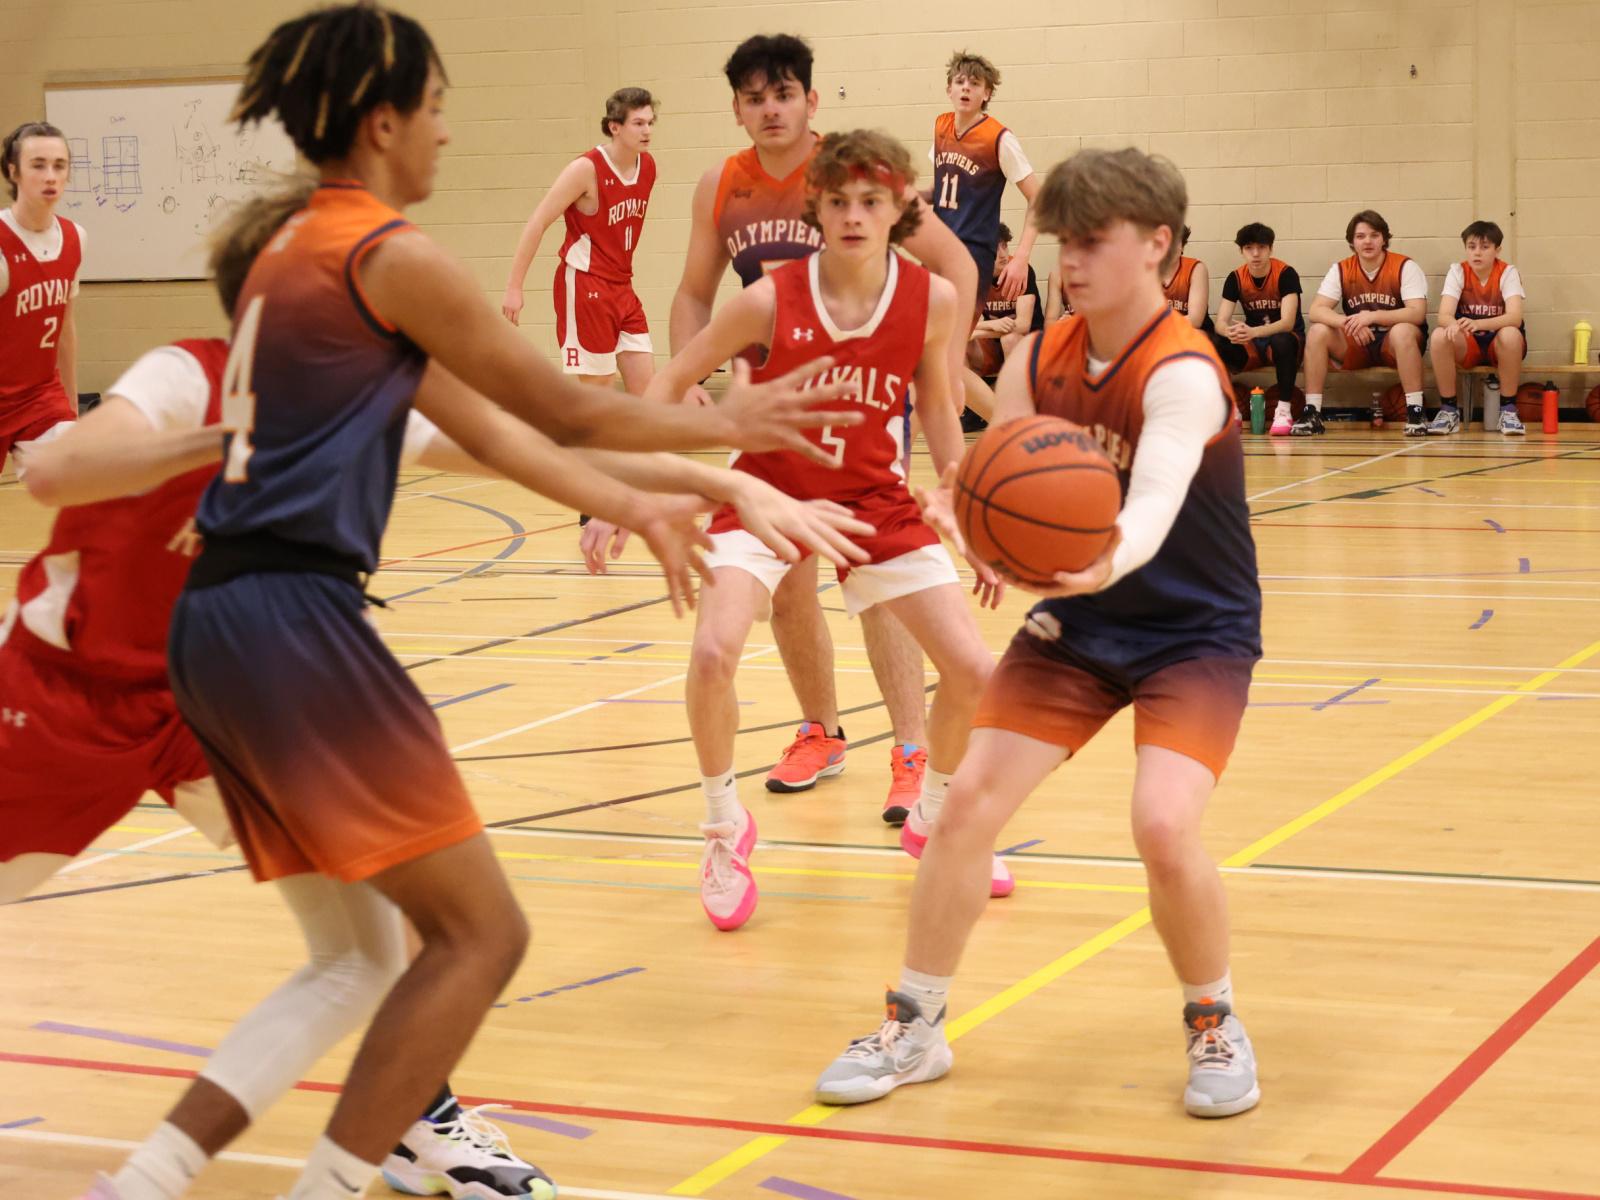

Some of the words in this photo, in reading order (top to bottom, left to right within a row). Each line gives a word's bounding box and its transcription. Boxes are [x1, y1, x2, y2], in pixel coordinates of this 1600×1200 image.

[938, 171, 959, 210] 11
[608, 198, 647, 226] ROYALS
[625, 225, 633, 251] 11
[16, 278, 69, 317] ROYAL
[1347, 292, 1397, 309] OLYMPIENS
[40, 316, 58, 348] 2
[566, 347, 580, 367] R
[222, 294, 267, 484] 4
